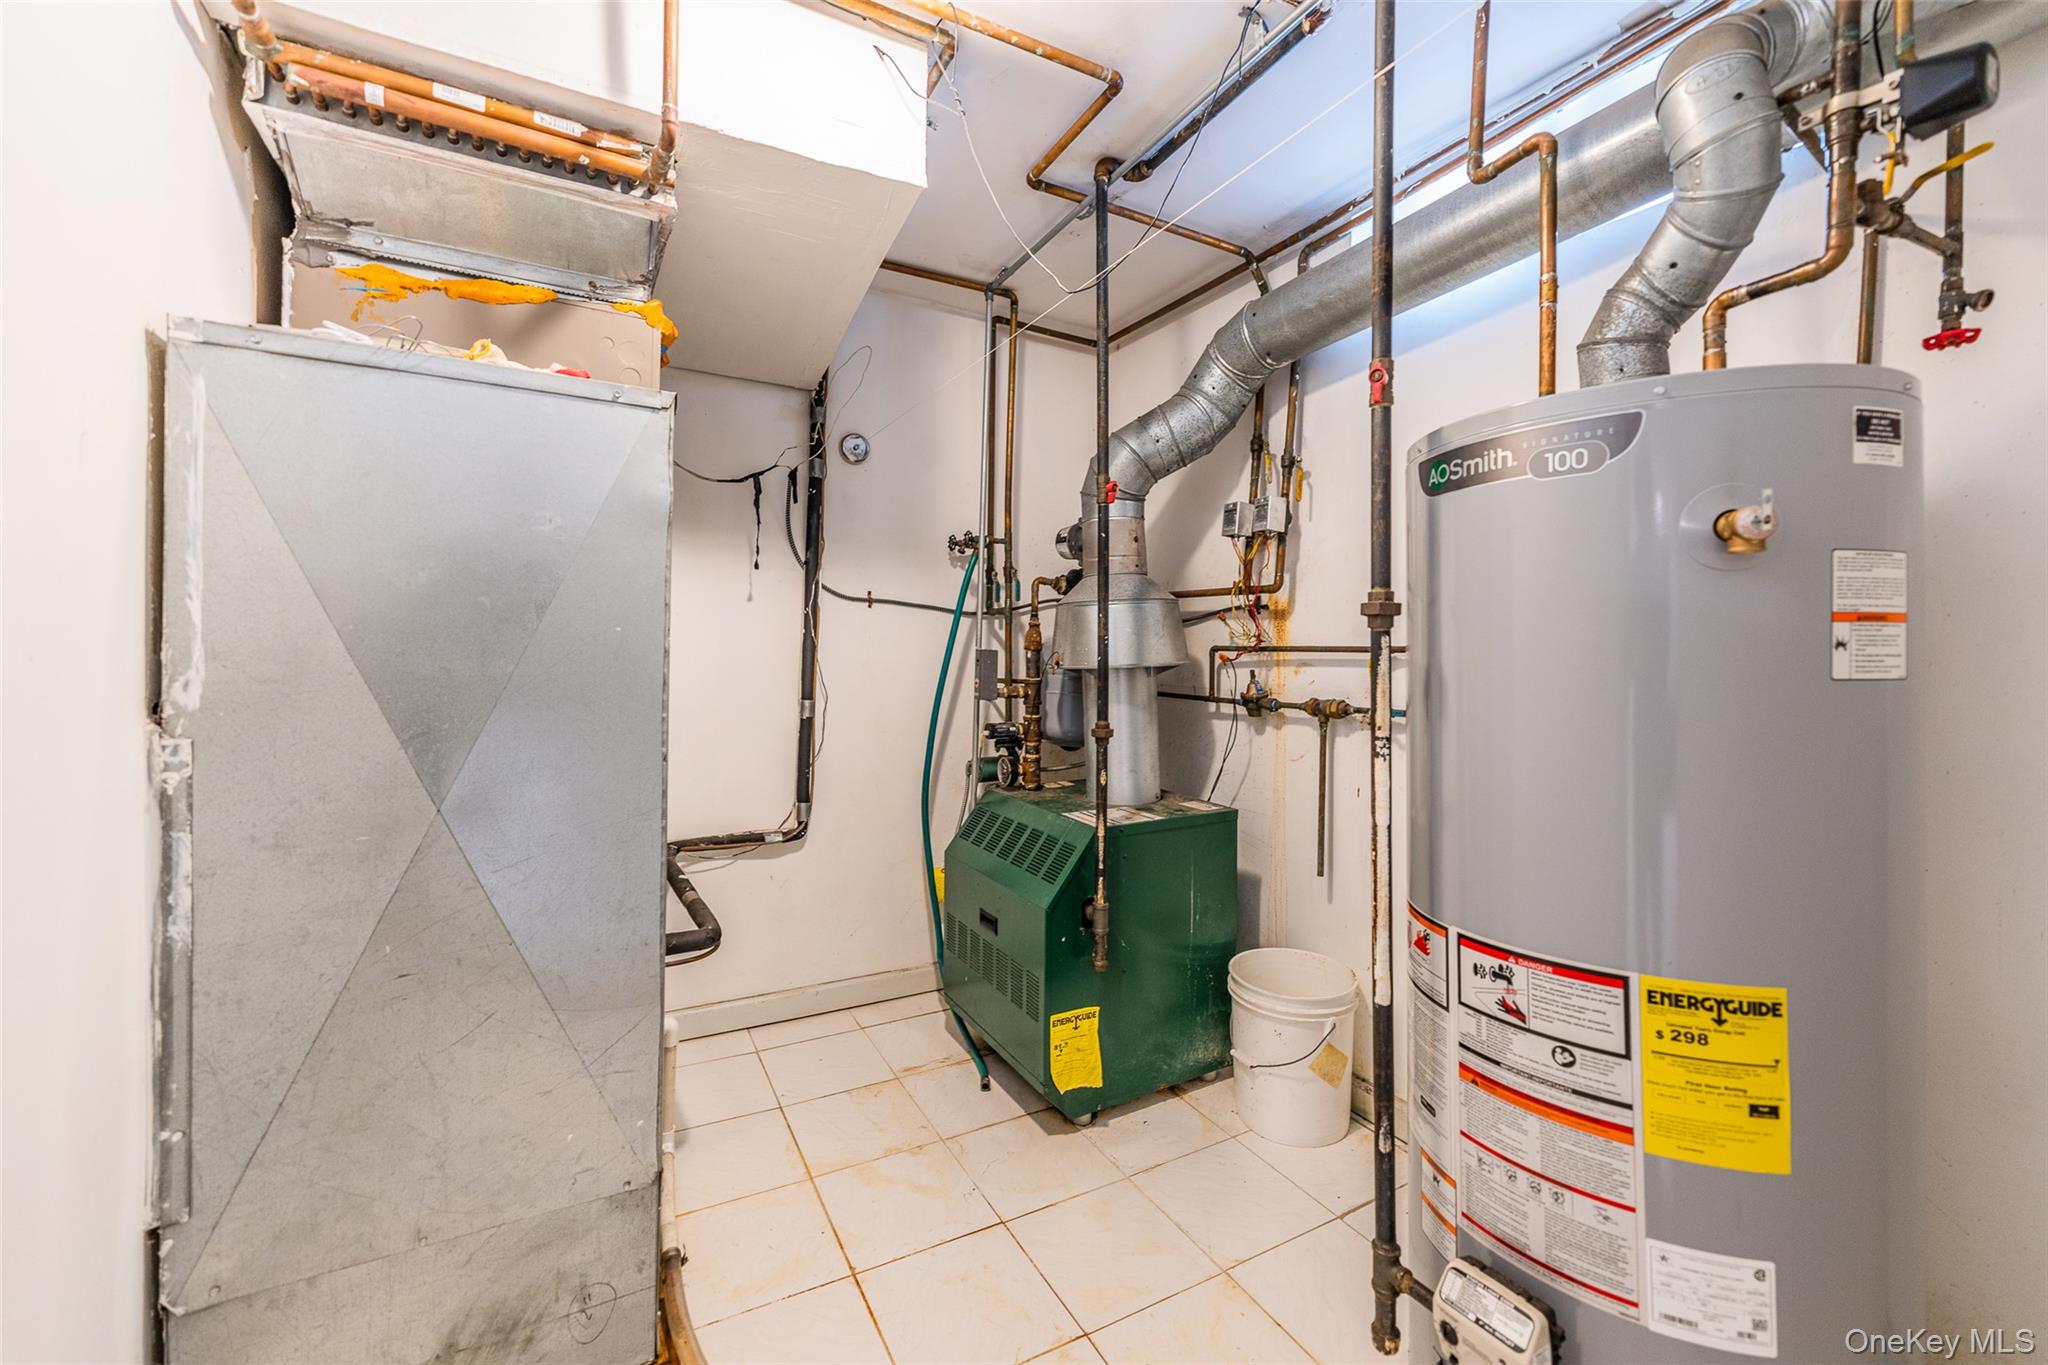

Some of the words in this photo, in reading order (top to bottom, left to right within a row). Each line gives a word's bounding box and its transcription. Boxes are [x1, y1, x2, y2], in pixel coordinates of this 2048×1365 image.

[1523, 427, 1615, 449] SIGNATURE
[1544, 448, 1588, 473] 100
[1517, 958, 1554, 974] DANGER
[1647, 989, 1783, 1018] ENERGYGUIDE
[1655, 1029, 1665, 1040] $
[1669, 1029, 1709, 1046] 298
